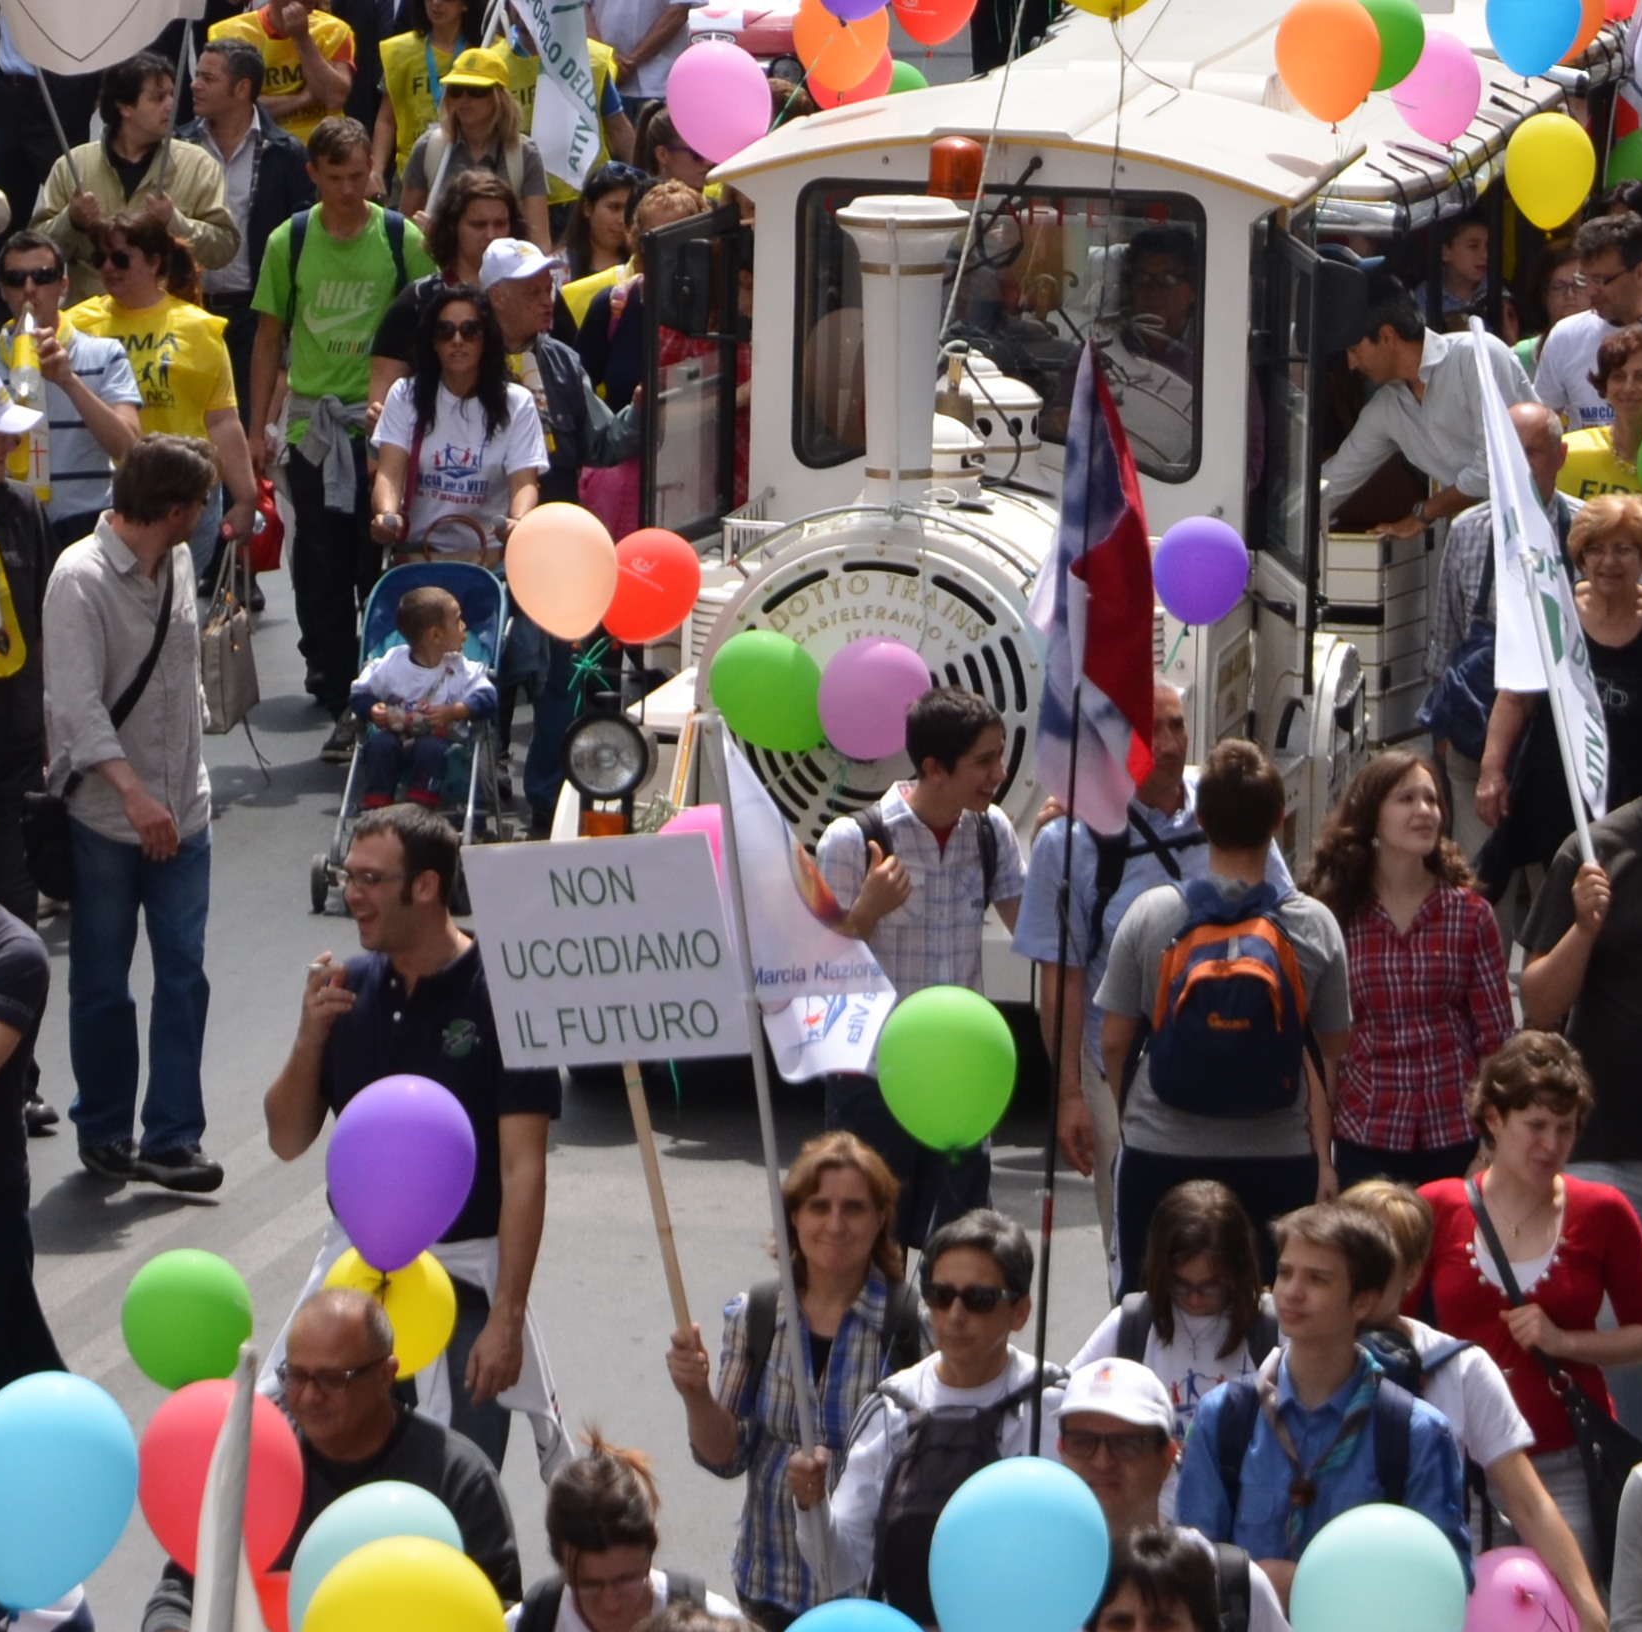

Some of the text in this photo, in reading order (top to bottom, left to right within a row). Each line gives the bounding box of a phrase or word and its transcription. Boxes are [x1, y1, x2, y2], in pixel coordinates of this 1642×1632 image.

[314, 280, 377, 309] NIKE
[768, 573, 988, 642] DOTTO TRAINS
[792, 605, 942, 645] CASTELFRANCO
[549, 864, 636, 908] NON
[500, 928, 722, 981] UCCIDIAMO
[514, 999, 720, 1049] IL FUTURO
